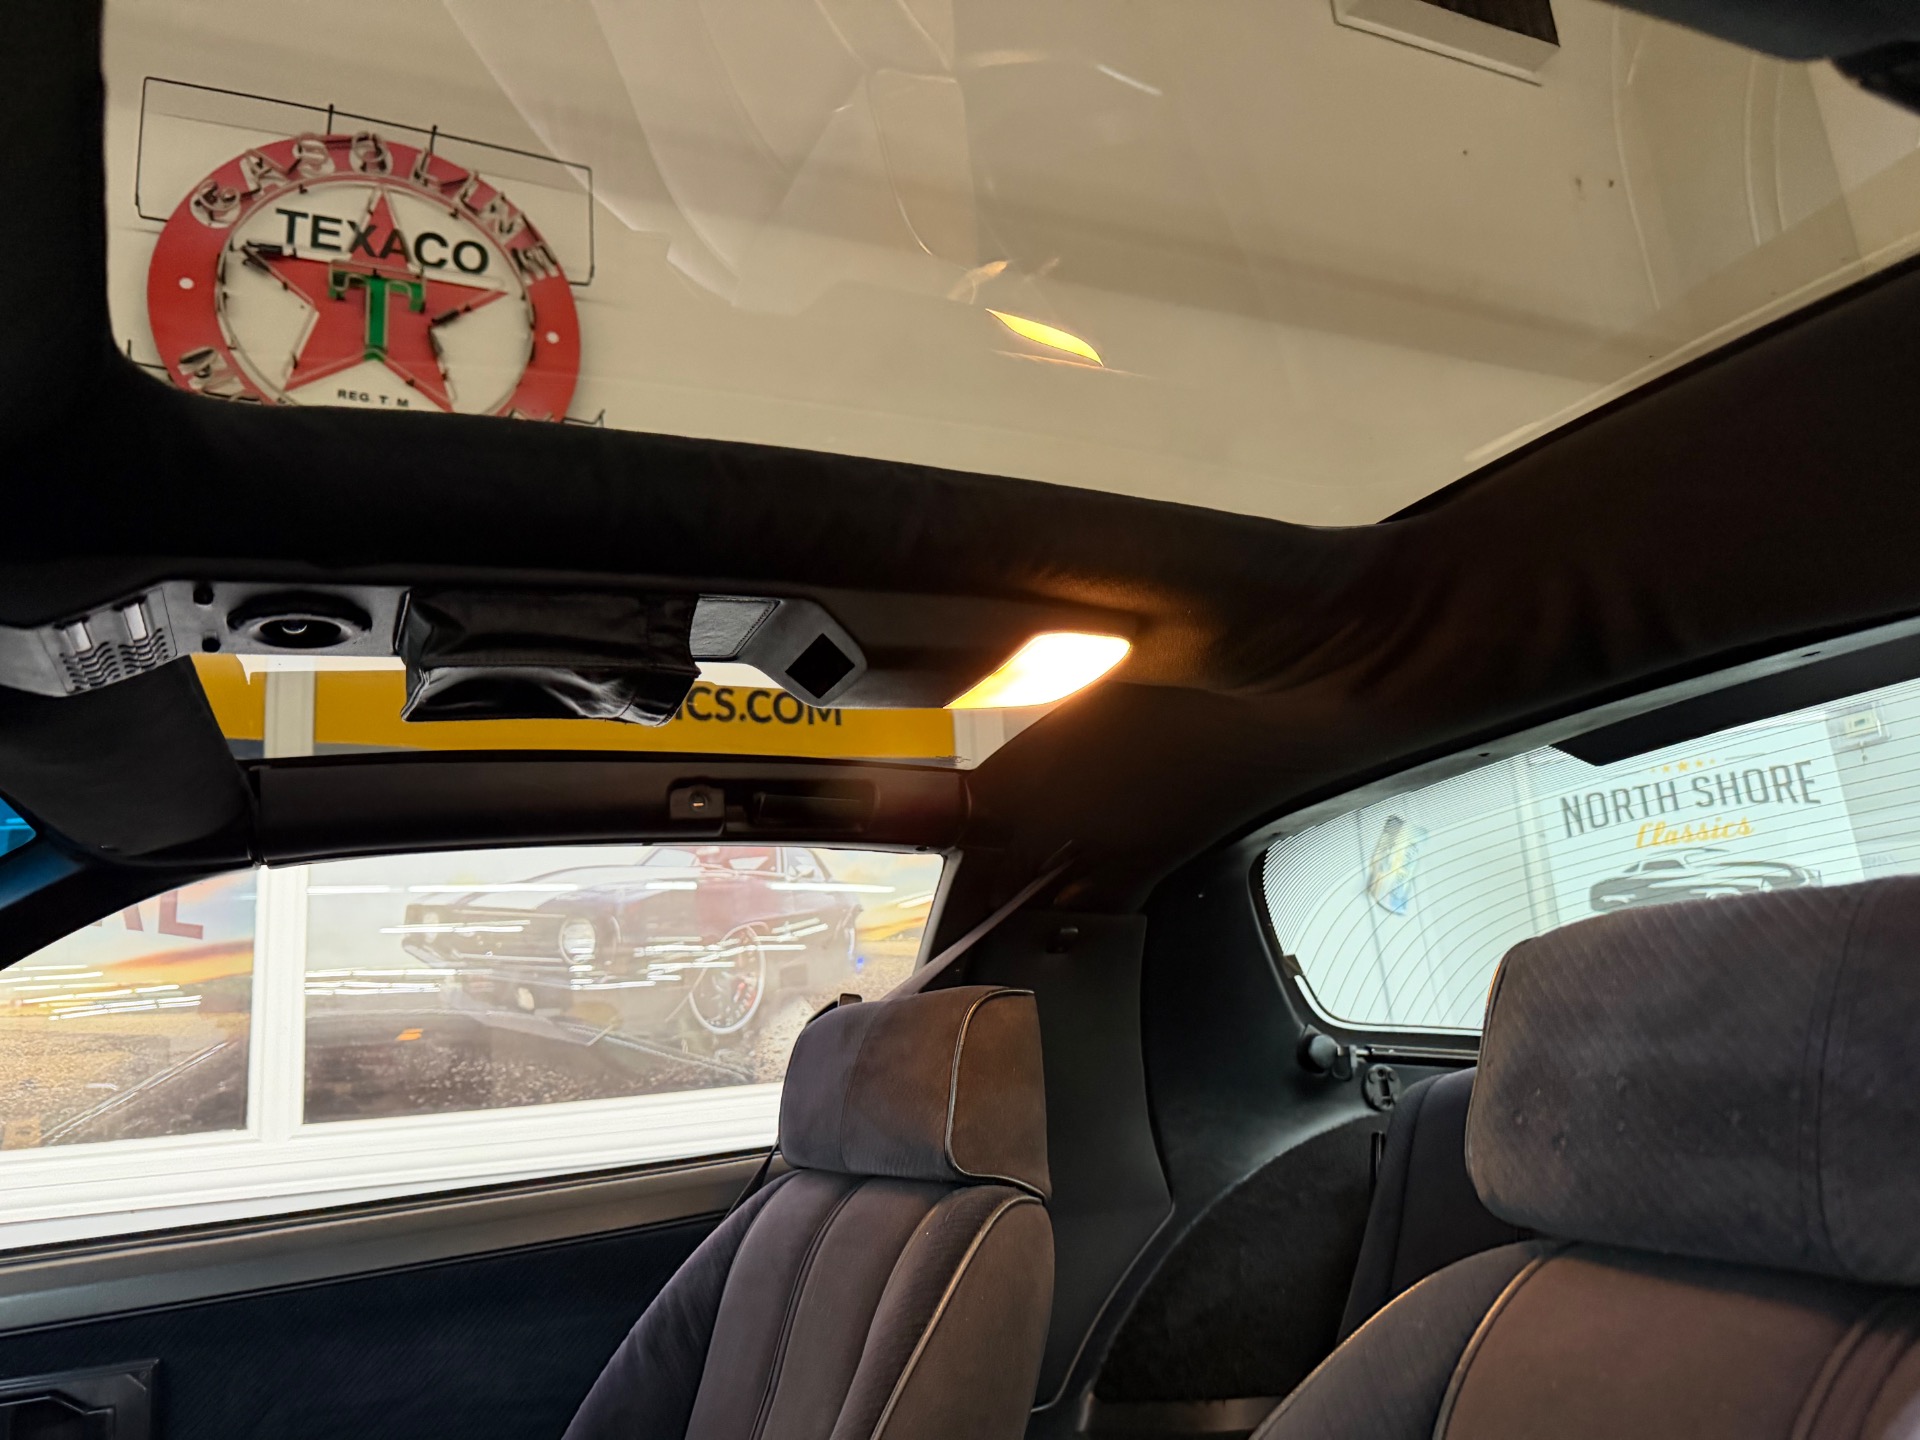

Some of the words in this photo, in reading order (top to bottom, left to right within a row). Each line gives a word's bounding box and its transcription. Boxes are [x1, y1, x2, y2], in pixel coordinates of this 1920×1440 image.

[275, 207, 490, 275] TEXACO
[1560, 780, 1680, 839] NORTH
[1690, 760, 1821, 809] SHORE
[1635, 816, 1754, 849] Classics
